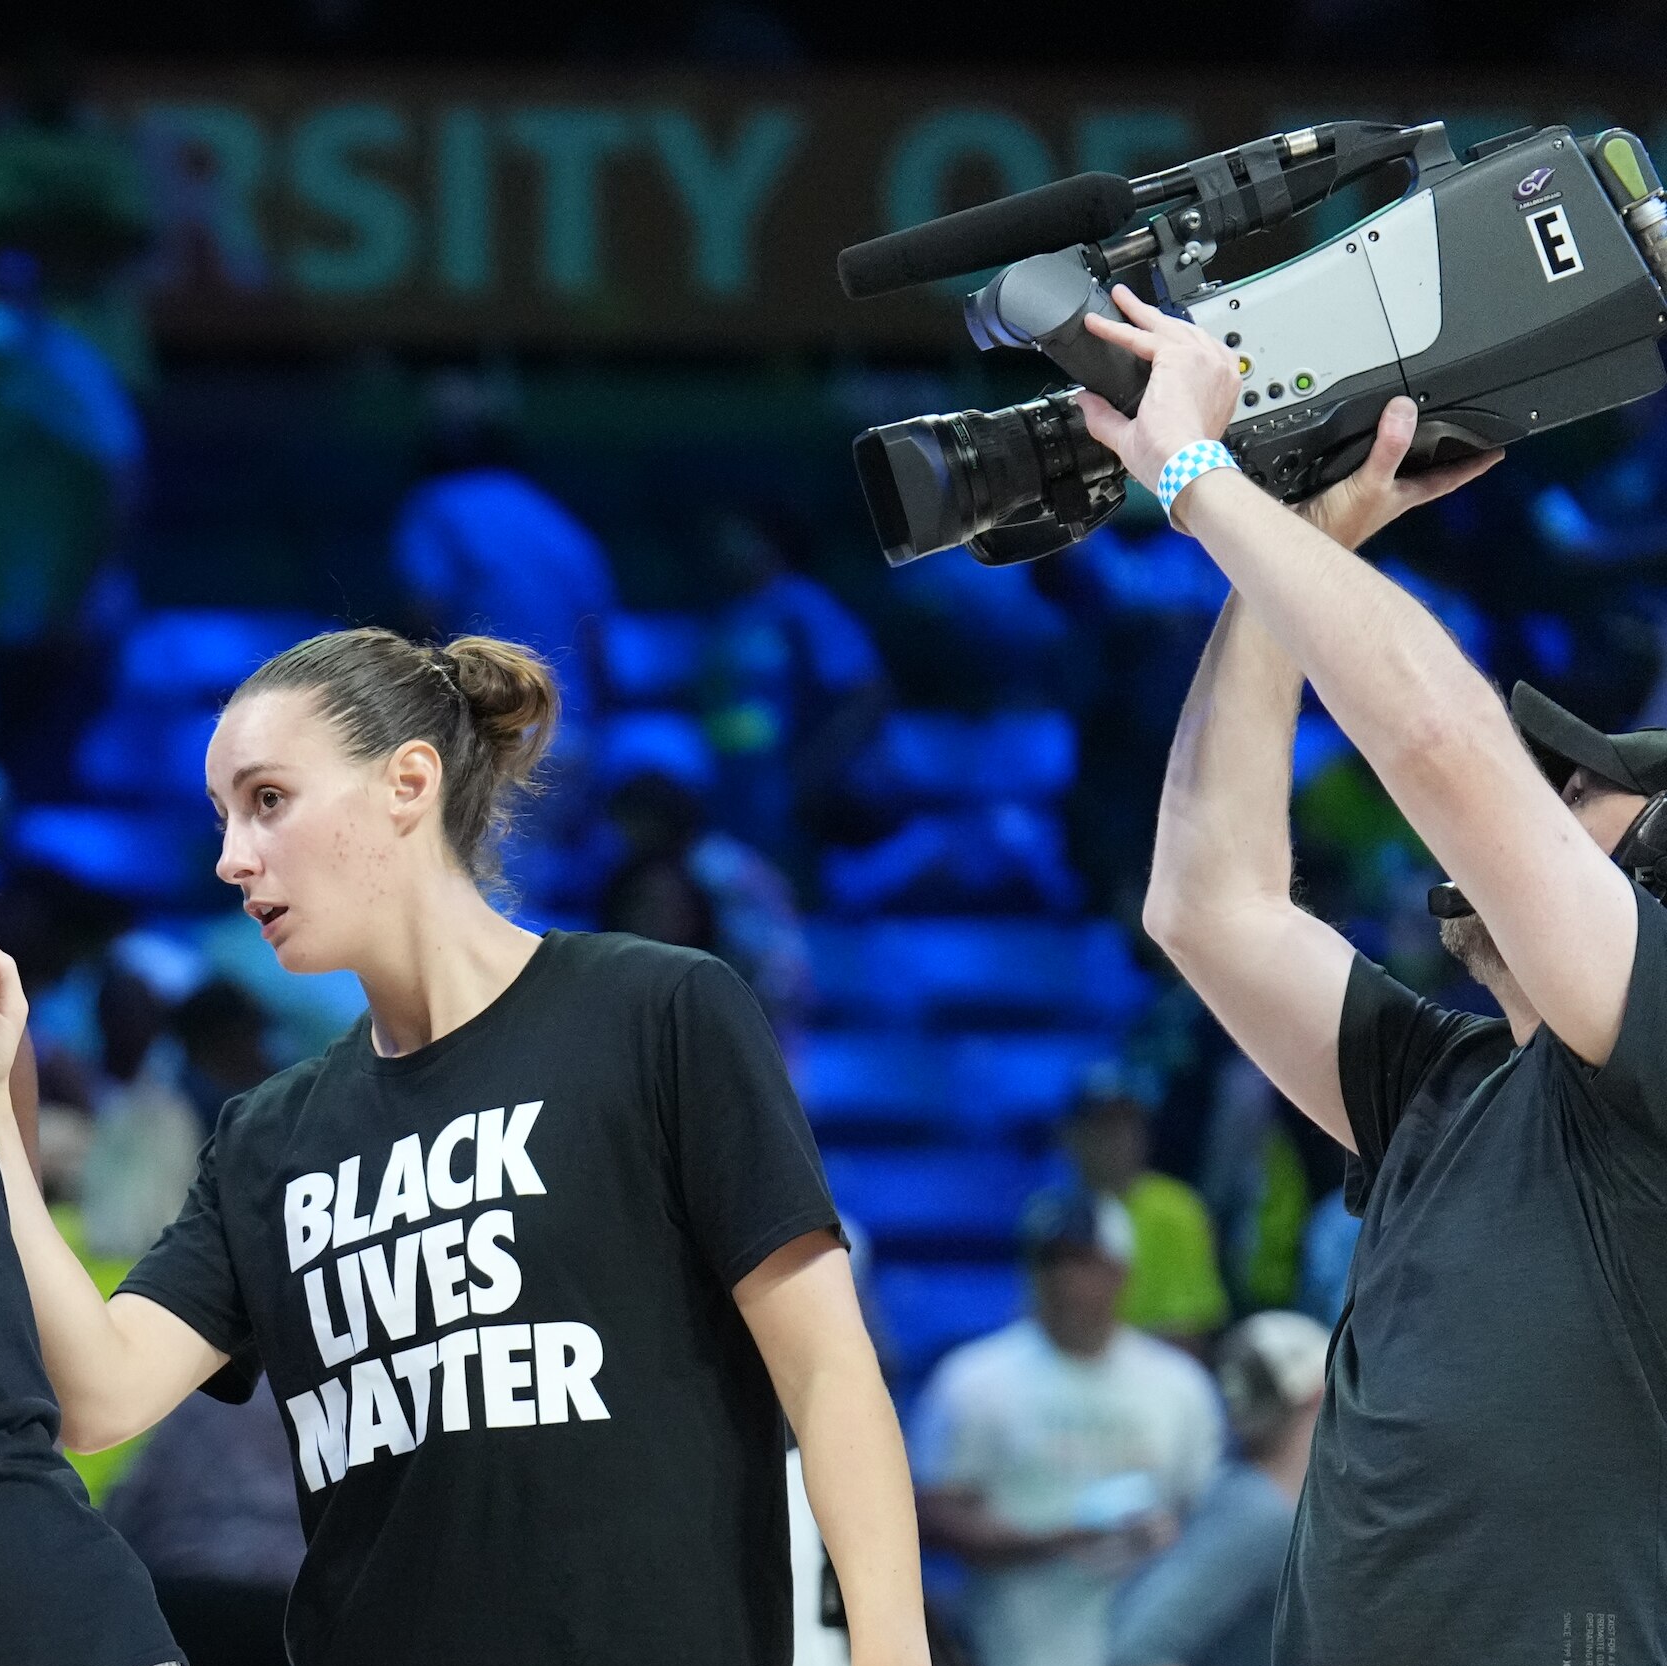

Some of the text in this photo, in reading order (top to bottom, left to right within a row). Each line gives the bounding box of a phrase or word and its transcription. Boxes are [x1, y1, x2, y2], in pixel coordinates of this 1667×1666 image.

[1533, 211, 1576, 275] E
[283, 1099, 548, 1274] BLACK
[303, 1208, 523, 1369] LIVES
[285, 1320, 612, 1494] MATTER
